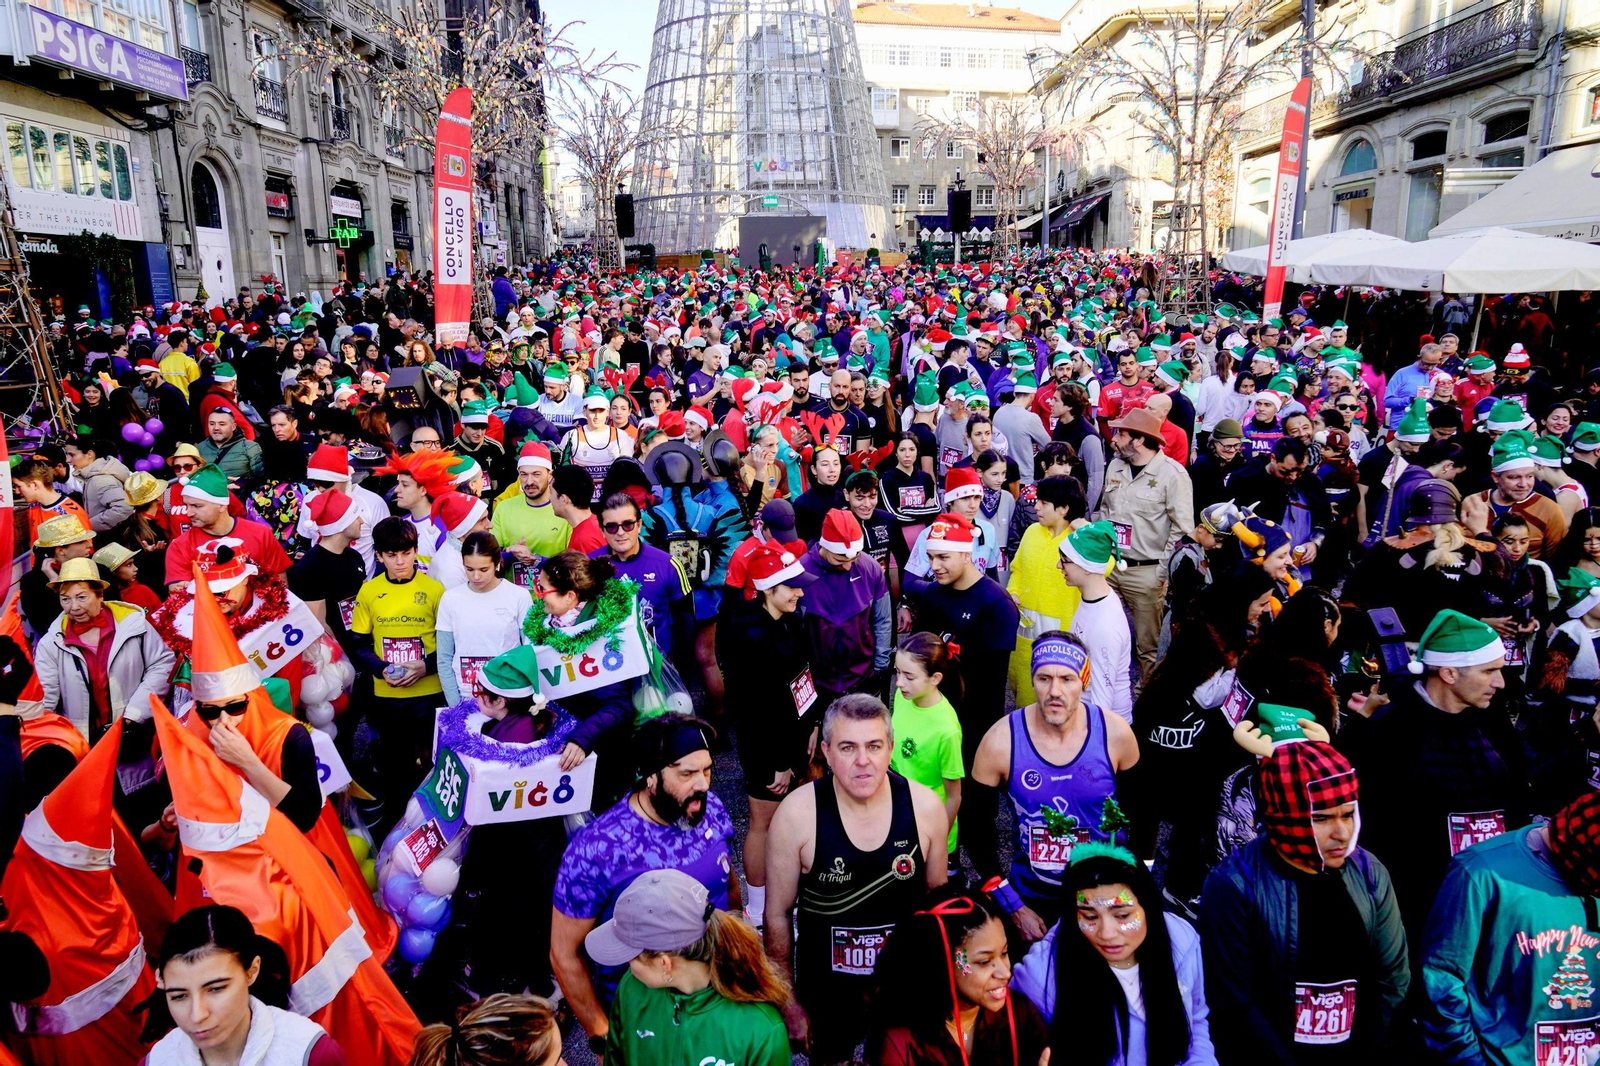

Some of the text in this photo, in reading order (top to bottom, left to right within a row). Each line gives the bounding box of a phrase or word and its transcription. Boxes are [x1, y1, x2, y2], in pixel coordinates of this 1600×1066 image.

[32, 11, 133, 81] PSICA
[18, 211, 113, 227] ER THE RAINBOW
[456, 207, 464, 243] VIGO
[444, 196, 456, 278] CONCELLO
[1350, 440, 1360, 450] 29
[392, 643, 413, 651] vigo
[386, 650, 417, 664] 3604
[445, 755, 462, 798] tic
[1028, 773, 1039, 784] 25
[435, 769, 459, 818] tac
[1469, 821, 1497, 832] vigo
[818, 872, 852, 884] El Trigal
[852, 936, 884, 946] vigo
[1516, 924, 1600, 958] Happy New
[844, 947, 882, 967] 109
[1310, 994, 1344, 1009] vigo
[1296, 1007, 1347, 1033] 4261
[1559, 1030, 1596, 1043] vigo
